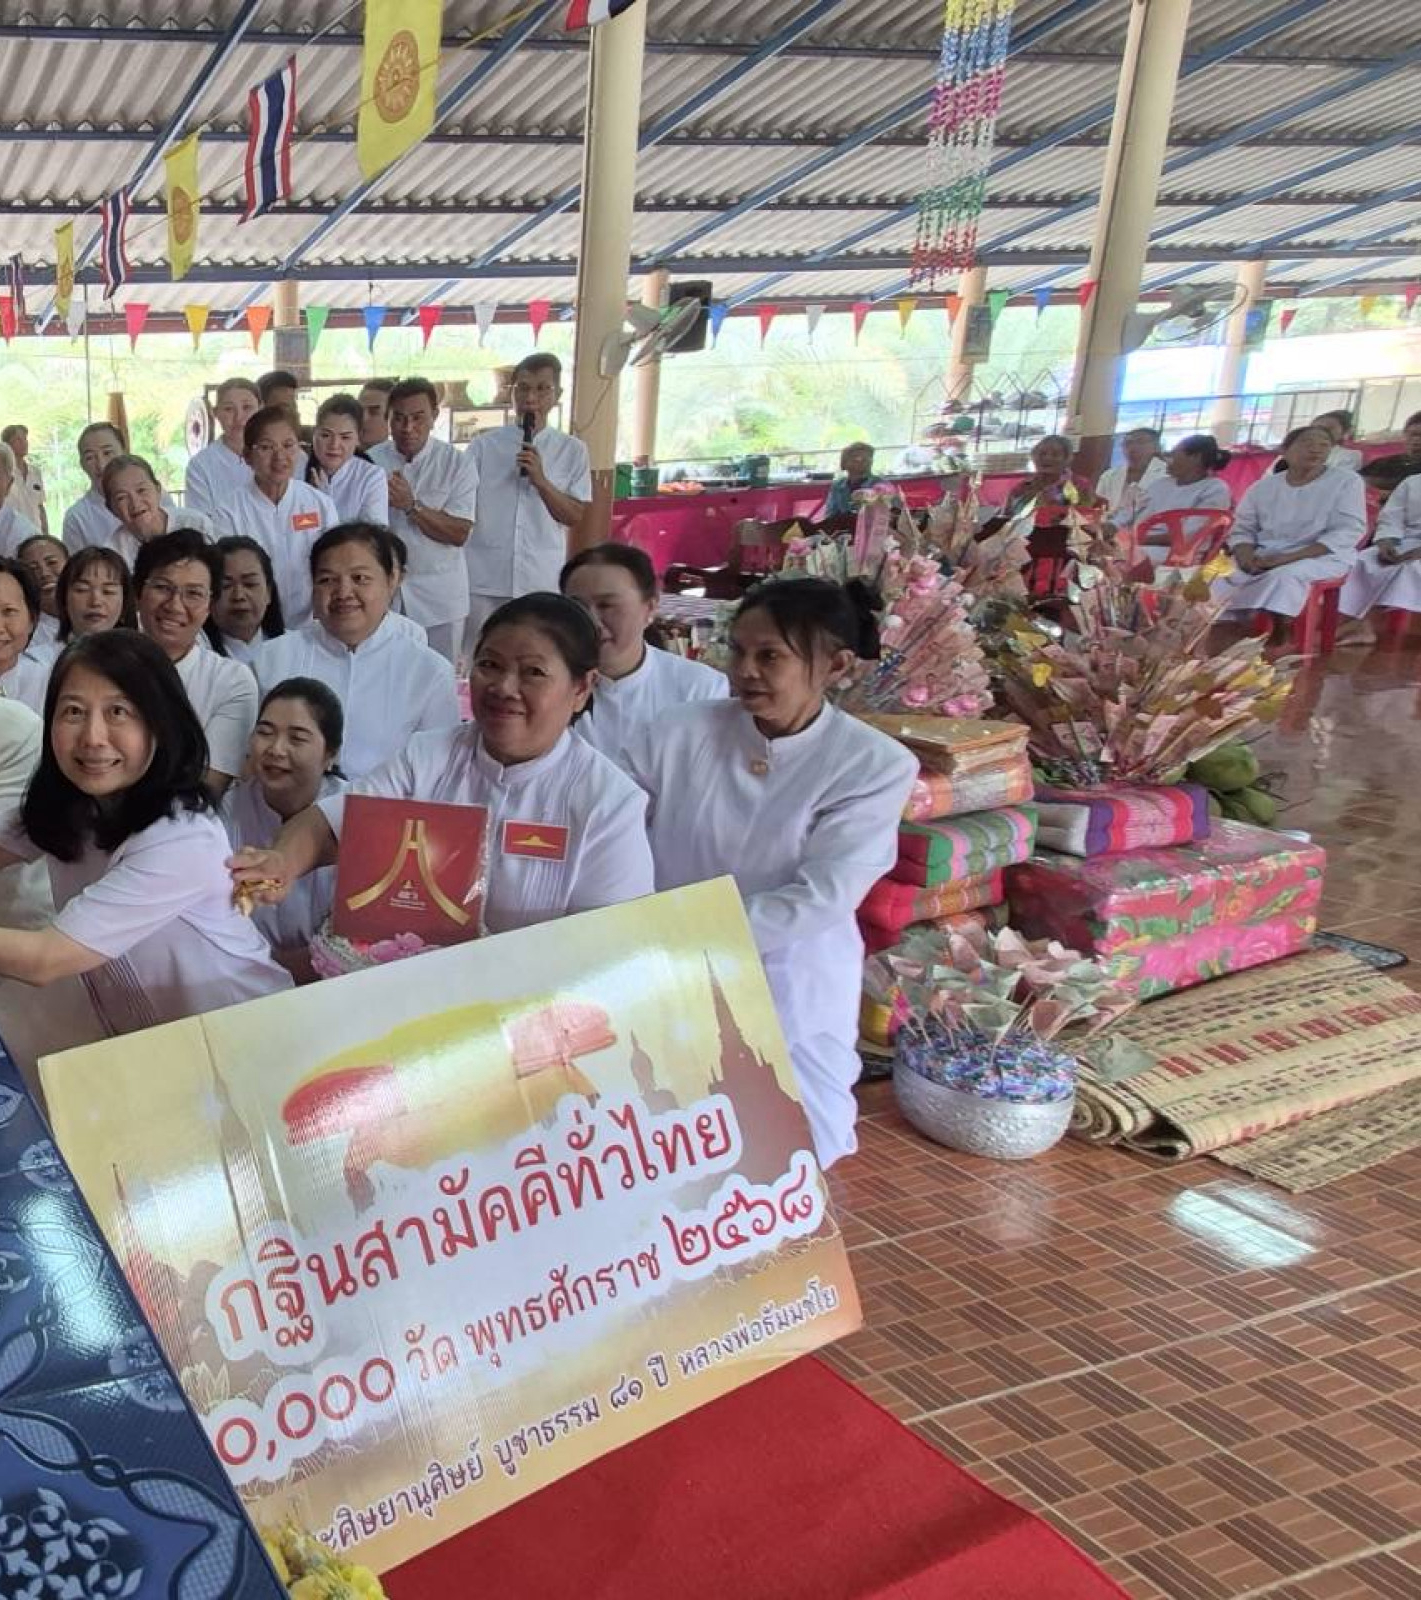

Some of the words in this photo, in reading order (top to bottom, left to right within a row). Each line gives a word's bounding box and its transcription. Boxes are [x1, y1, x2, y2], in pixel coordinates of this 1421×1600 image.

[220, 1104, 731, 1347] กฐินสามัคคีทั่วไทย
[405, 1324, 460, 1381] วัด
[465, 1243, 661, 1368] พุทธศักราช
[662, 1164, 814, 1266] ๒๕๖๘
[314, 1439, 484, 1549] ะศิษยานุศิษย์
[493, 1397, 601, 1476] บูชาธรรม
[610, 1376, 644, 1410] ๘๑
[648, 1354, 669, 1388] ปี
